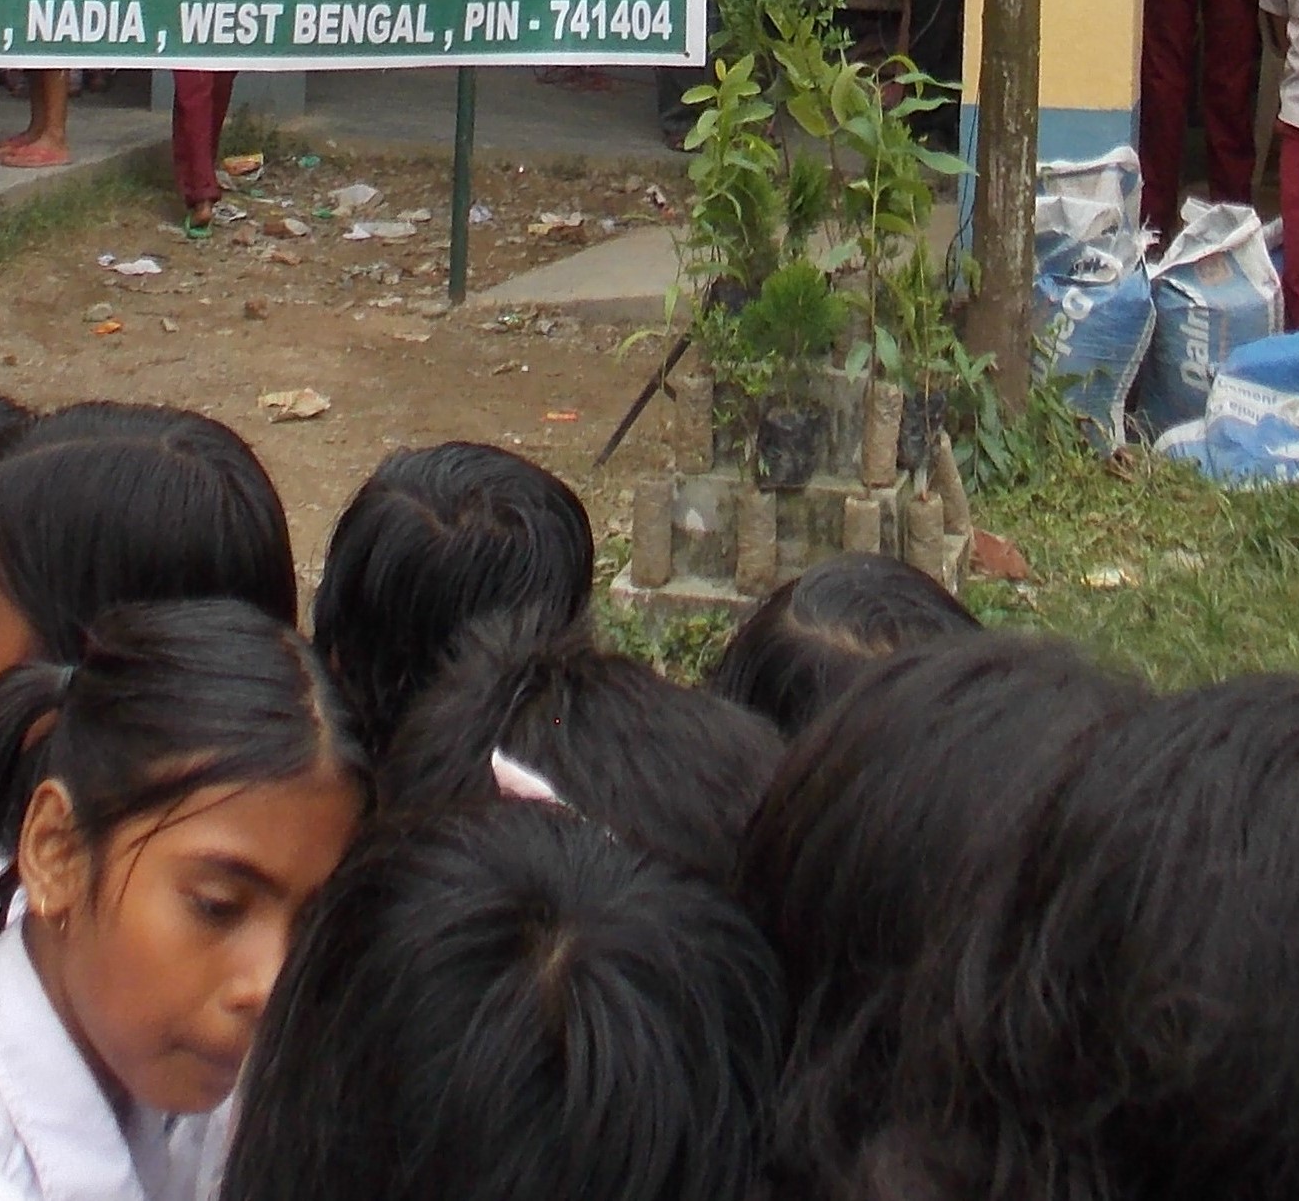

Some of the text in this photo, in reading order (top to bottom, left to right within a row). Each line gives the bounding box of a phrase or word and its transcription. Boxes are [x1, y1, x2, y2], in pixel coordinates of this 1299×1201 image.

[27, 0, 148, 45] NADIA
[180, 2, 284, 45] WEST
[293, 2, 435, 46] BENGAL
[464, 2, 520, 42] PIN
[550, 0, 674, 42] 741404
